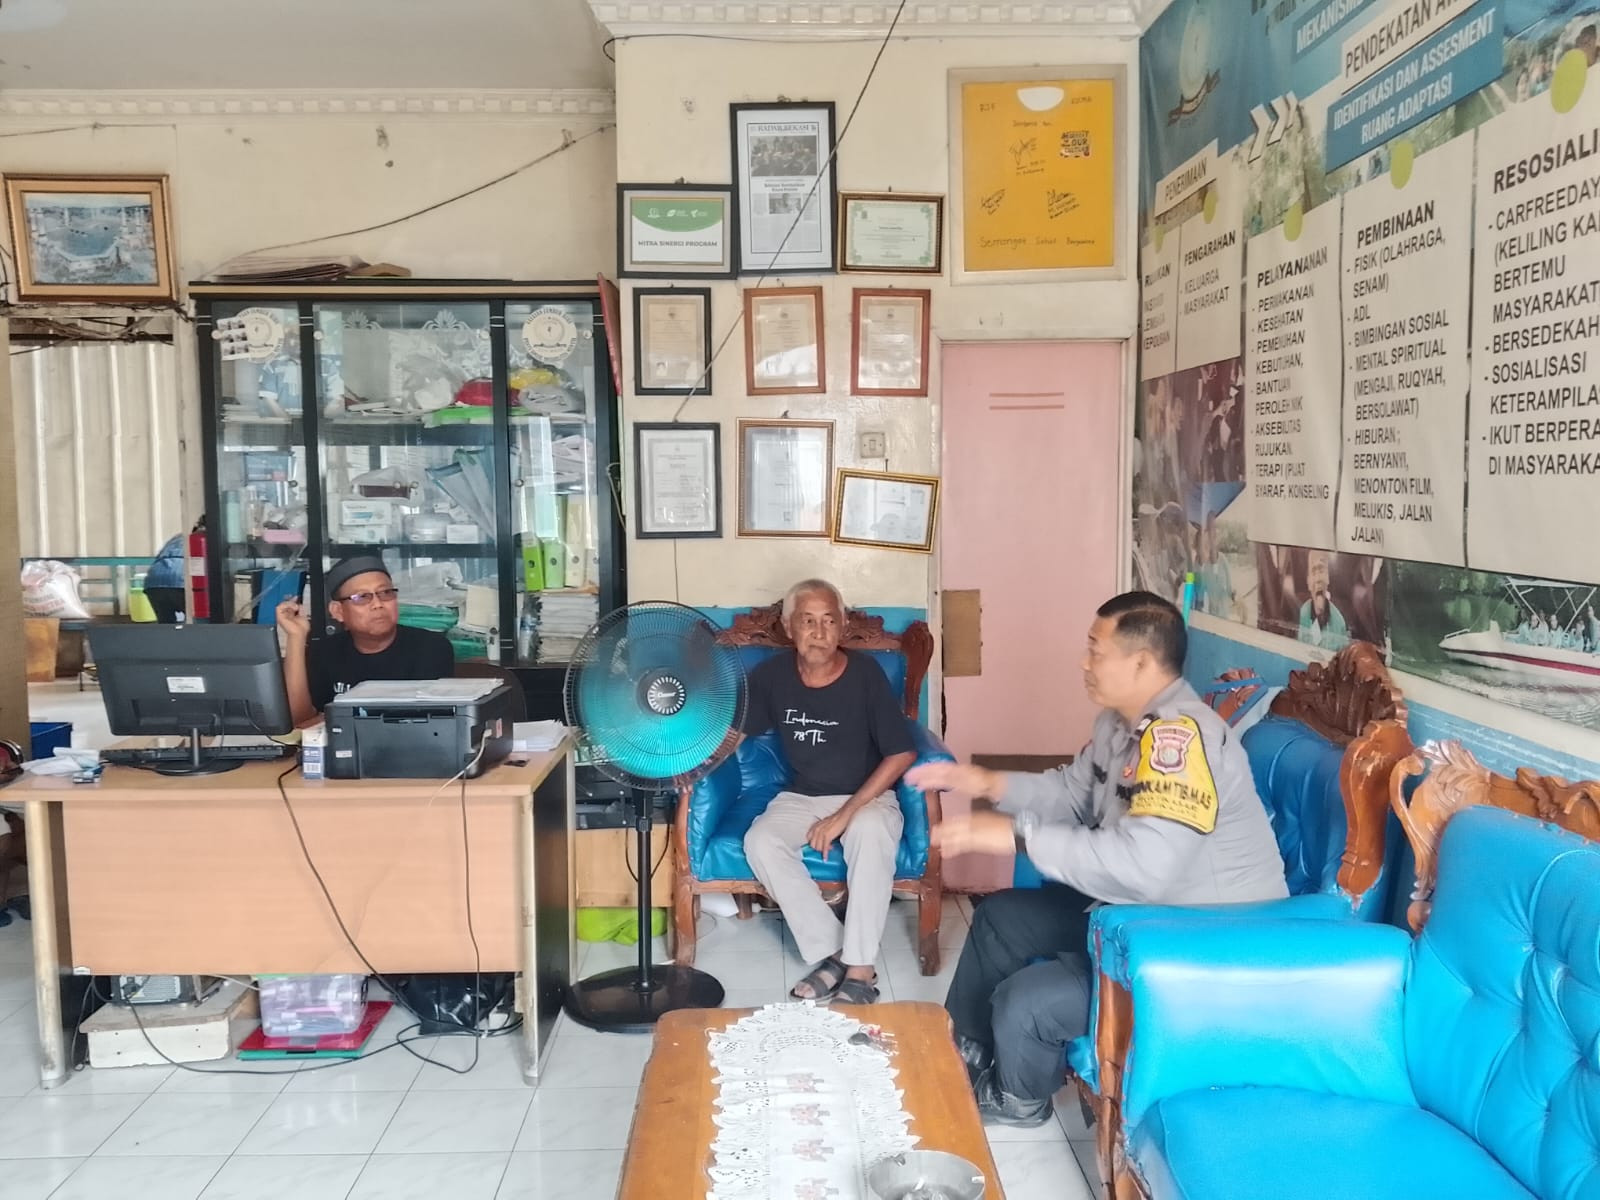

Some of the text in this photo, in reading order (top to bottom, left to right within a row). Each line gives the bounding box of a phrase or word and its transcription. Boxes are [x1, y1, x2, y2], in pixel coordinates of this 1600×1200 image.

[1345, 0, 1431, 79] PENDEKATAN
[1334, 7, 1496, 131] IDENTIFIKASI DAN ASSESMENT
[1361, 71, 1453, 145] RUANG ADAPTASI
[1357, 199, 1434, 249] PEMBINAAN
[1494, 209, 1600, 268] (KELILING KA
[1184, 229, 1236, 267] PENGARAHAN
[1354, 226, 1446, 275] FISIK (OLAHRAGA,
[1353, 272, 1389, 299] SENAM)
[1494, 254, 1566, 293] BERTEMU
[1184, 285, 1230, 316] MASYARAKAT
[1353, 304, 1371, 323] ADL
[1257, 308, 1304, 334] KESEHATAN
[1354, 309, 1450, 348] BIMBINGAN SOSIAL
[1493, 314, 1600, 354] BERSEDEKAH
[1355, 338, 1447, 372] MENTAL SPIRITUAL
[1492, 351, 1587, 384] SOSIALISASI
[1398, 365, 1446, 390] RUQYAH,
[1355, 397, 1419, 421] BERSOLAWAT)
[1490, 424, 1521, 445] IKUT
[1255, 463, 1283, 478] TERAPI
[1354, 452, 1409, 471] BERNYANYI,
[1489, 455, 1501, 475] DI
[1288, 484, 1330, 500] KONSELING
[1354, 478, 1435, 499] MENONTON FILM,
[1354, 502, 1433, 523] MELUKIS, JALAN
[1351, 526, 1385, 549] JALAN)
